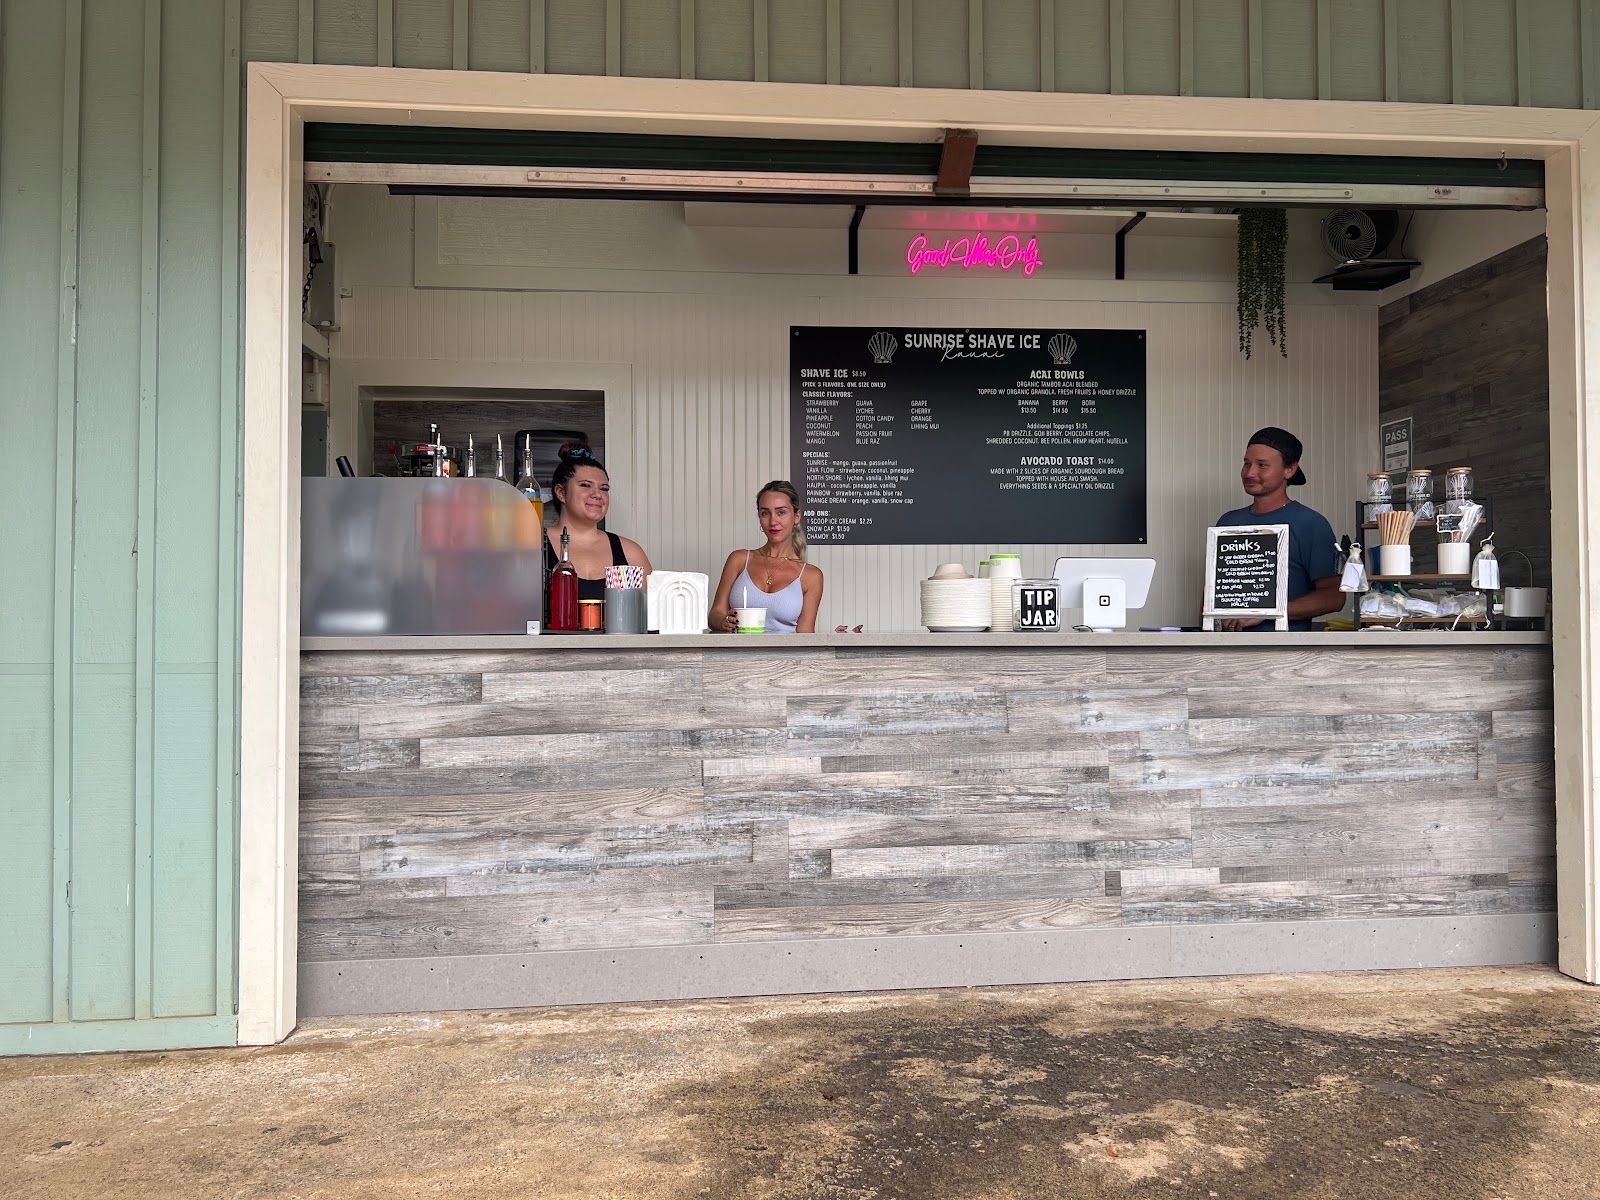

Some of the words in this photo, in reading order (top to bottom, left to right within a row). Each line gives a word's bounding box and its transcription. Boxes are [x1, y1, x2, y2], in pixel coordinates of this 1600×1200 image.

[908, 236, 949, 273] Good
[950, 232, 997, 267] Vibes
[997, 235, 1043, 275] Only
[904, 334, 964, 348] SUNRISE
[968, 334, 1015, 348] SHAVE
[1020, 334, 1041, 348] ICE
[941, 344, 1005, 362] Kauai
[801, 369, 830, 378] SHAVE
[834, 369, 848, 378] ICE
[1030, 370, 1051, 379] ACAI
[1055, 370, 1084, 379] BOWLS
[1386, 428, 1407, 443] PASS
[1021, 457, 1062, 466] AVOCADO
[1066, 457, 1094, 466] TOAST
[1025, 590, 1054, 605] TIP
[1022, 610, 1055, 625] JAR
